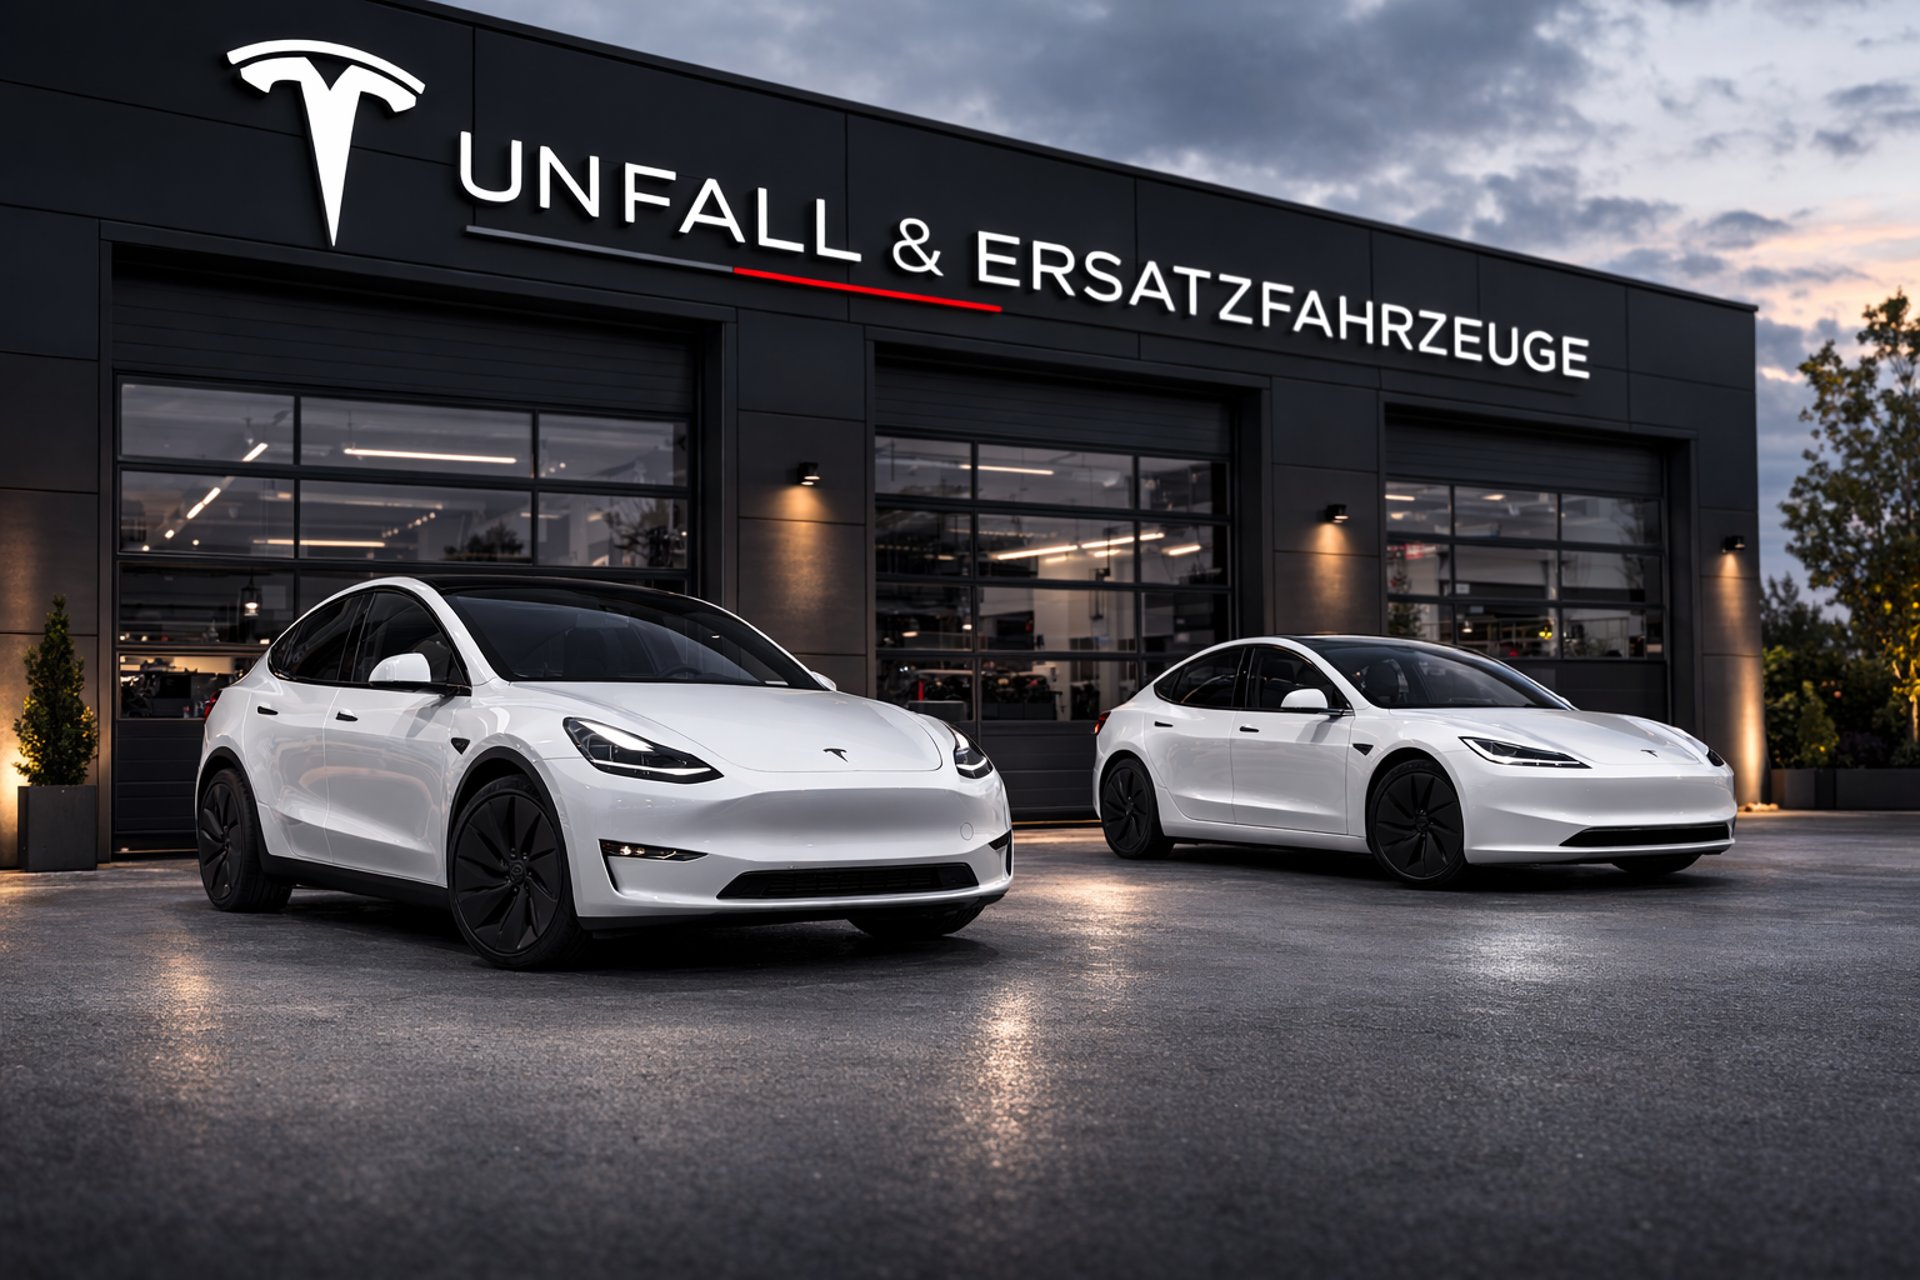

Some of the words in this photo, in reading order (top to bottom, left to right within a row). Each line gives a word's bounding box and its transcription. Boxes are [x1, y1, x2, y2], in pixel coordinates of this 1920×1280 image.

[459, 131, 862, 263] UNFALL
[892, 217, 944, 277] &
[976, 230, 1591, 380] ERSATZFAHRZEUGE
